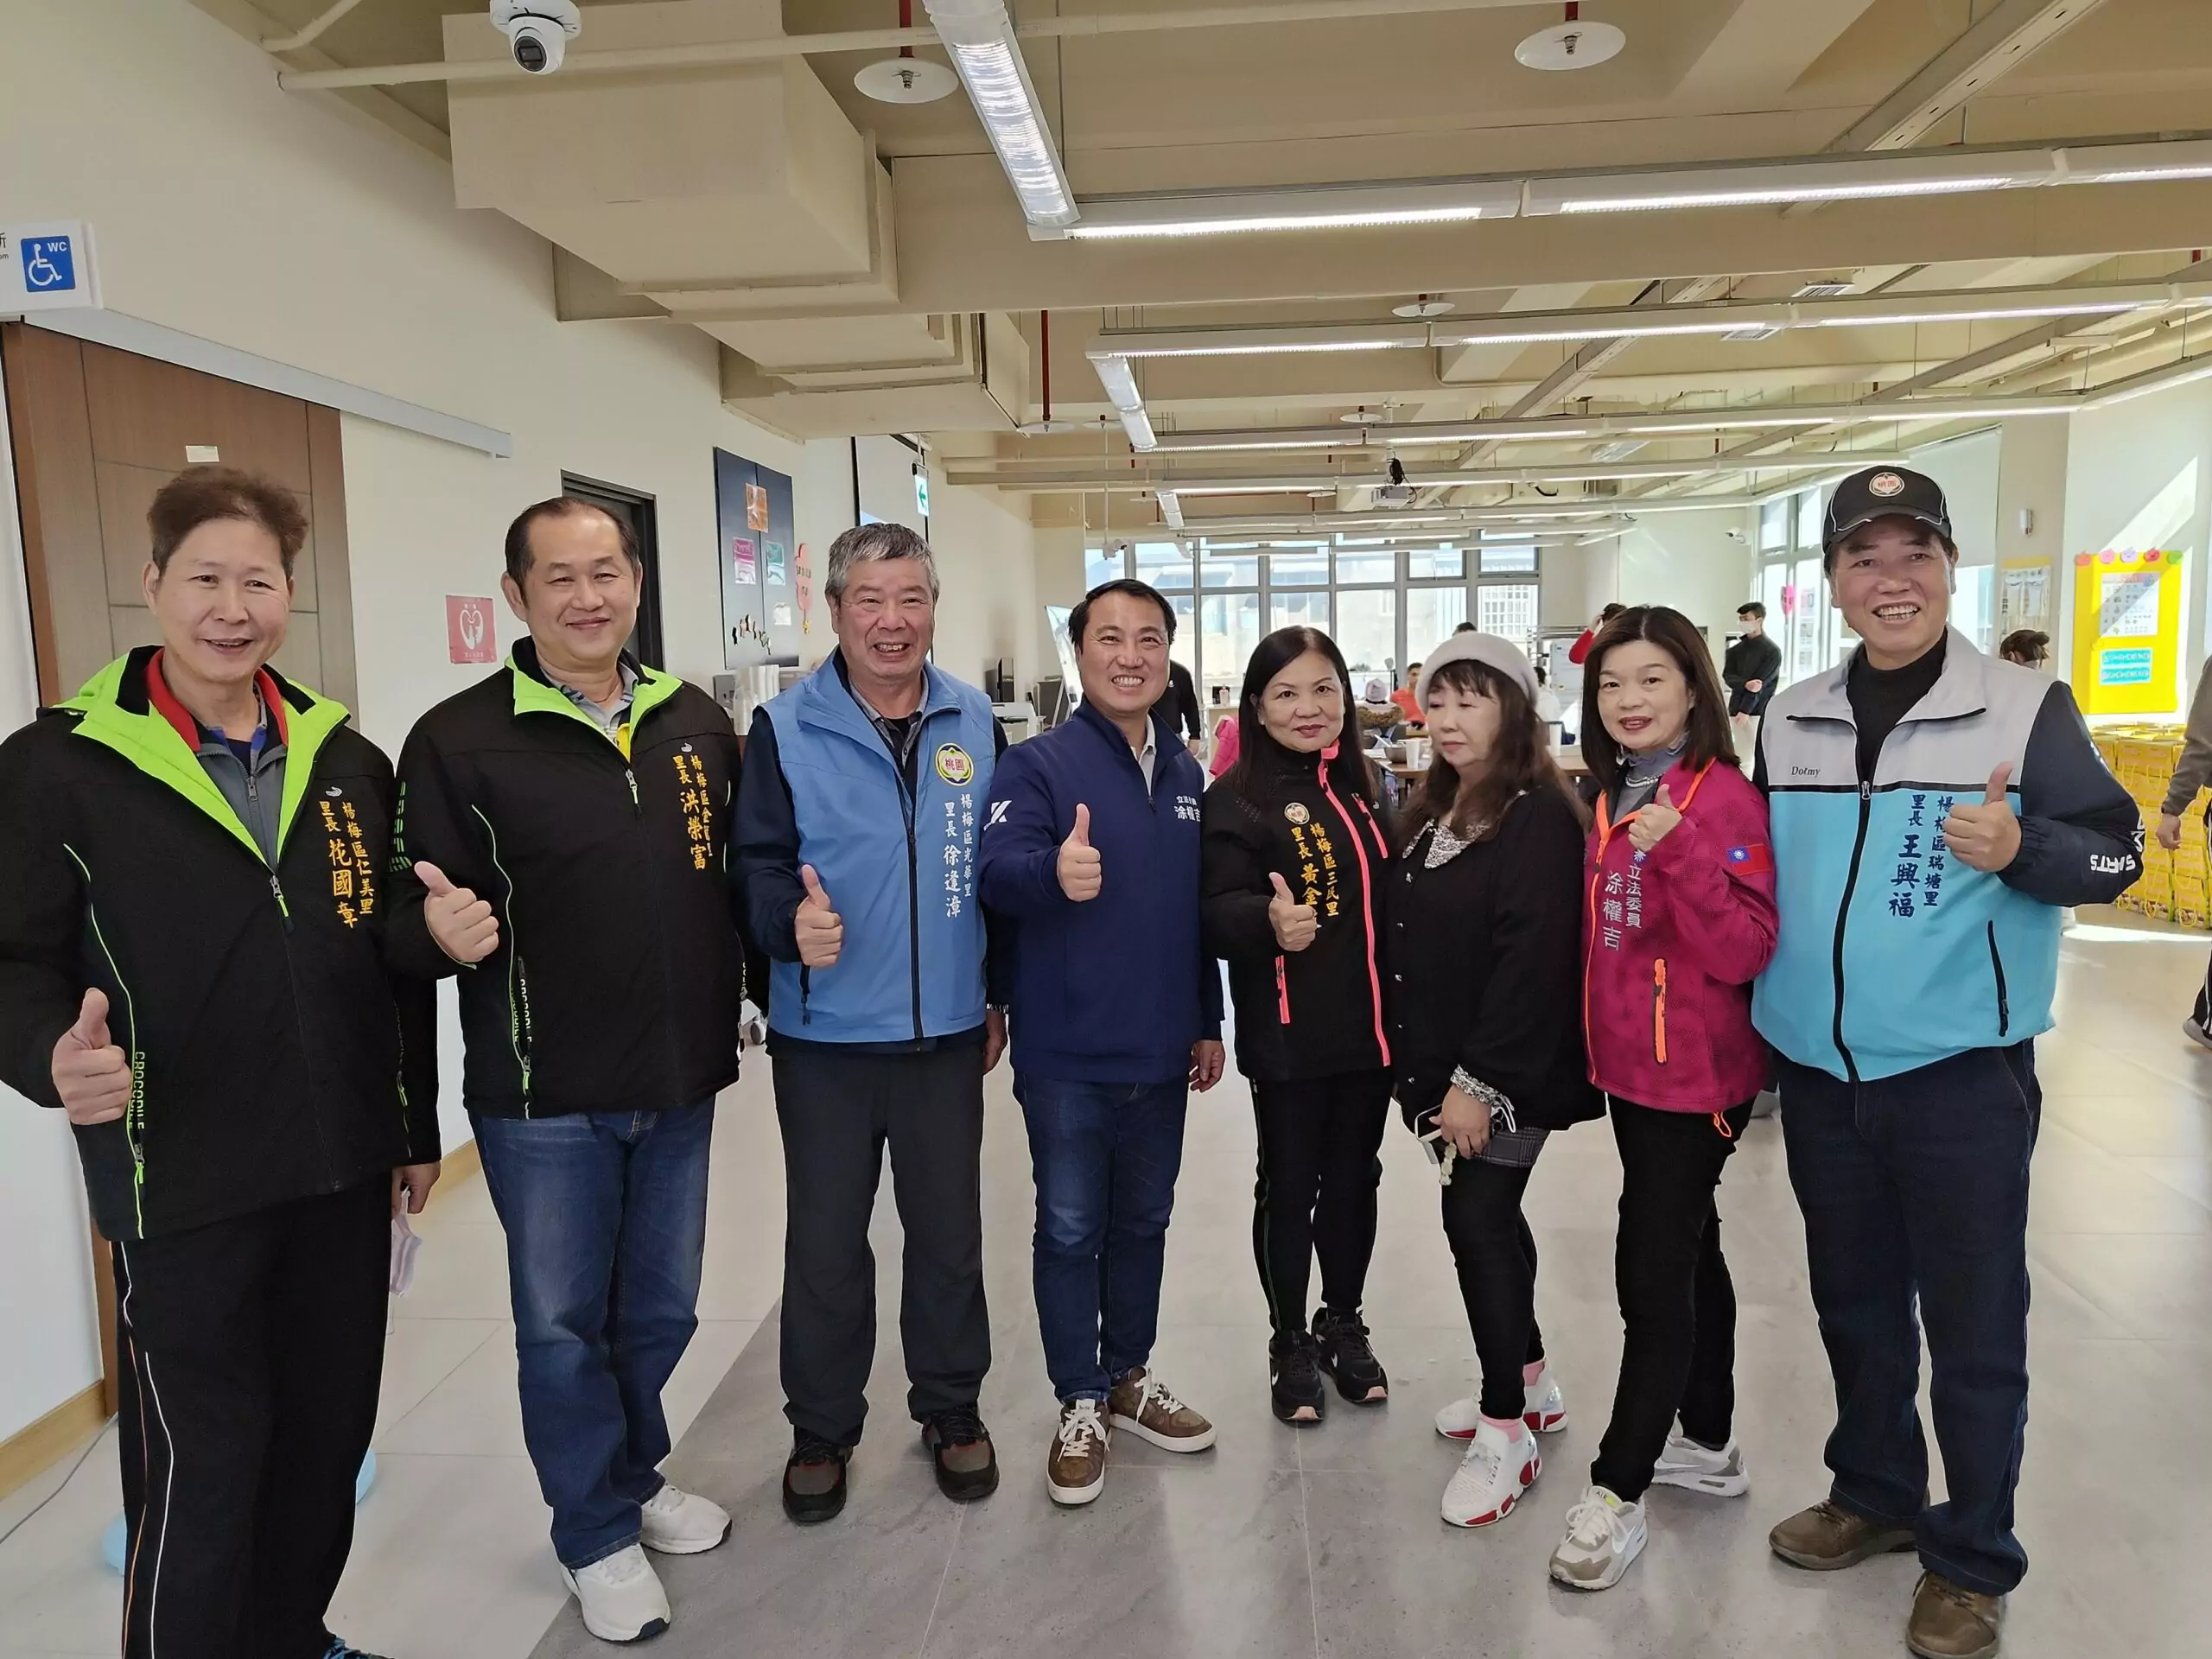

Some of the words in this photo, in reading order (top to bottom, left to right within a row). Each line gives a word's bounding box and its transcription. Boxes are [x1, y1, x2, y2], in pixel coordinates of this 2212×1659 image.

[47, 241, 67, 252] WC
[672, 754, 693, 785] 里長
[944, 757, 965, 772] 桃園
[319, 800, 342, 833] 里長
[690, 754, 714, 857] 楊梅區金
[944, 801, 958, 838] 里長
[1908, 793, 1927, 827] 里長
[341, 801, 375, 915] 楊梅區仁美里
[960, 792, 974, 898] 楊梅區光華里
[1291, 826, 1313, 860] 里長
[1309, 822, 1340, 918] 楊梅區三民里
[1888, 833, 1923, 918] 王興福
[1602, 869, 1624, 951] 涂權吉
[1625, 863, 1643, 930] 立法委員
